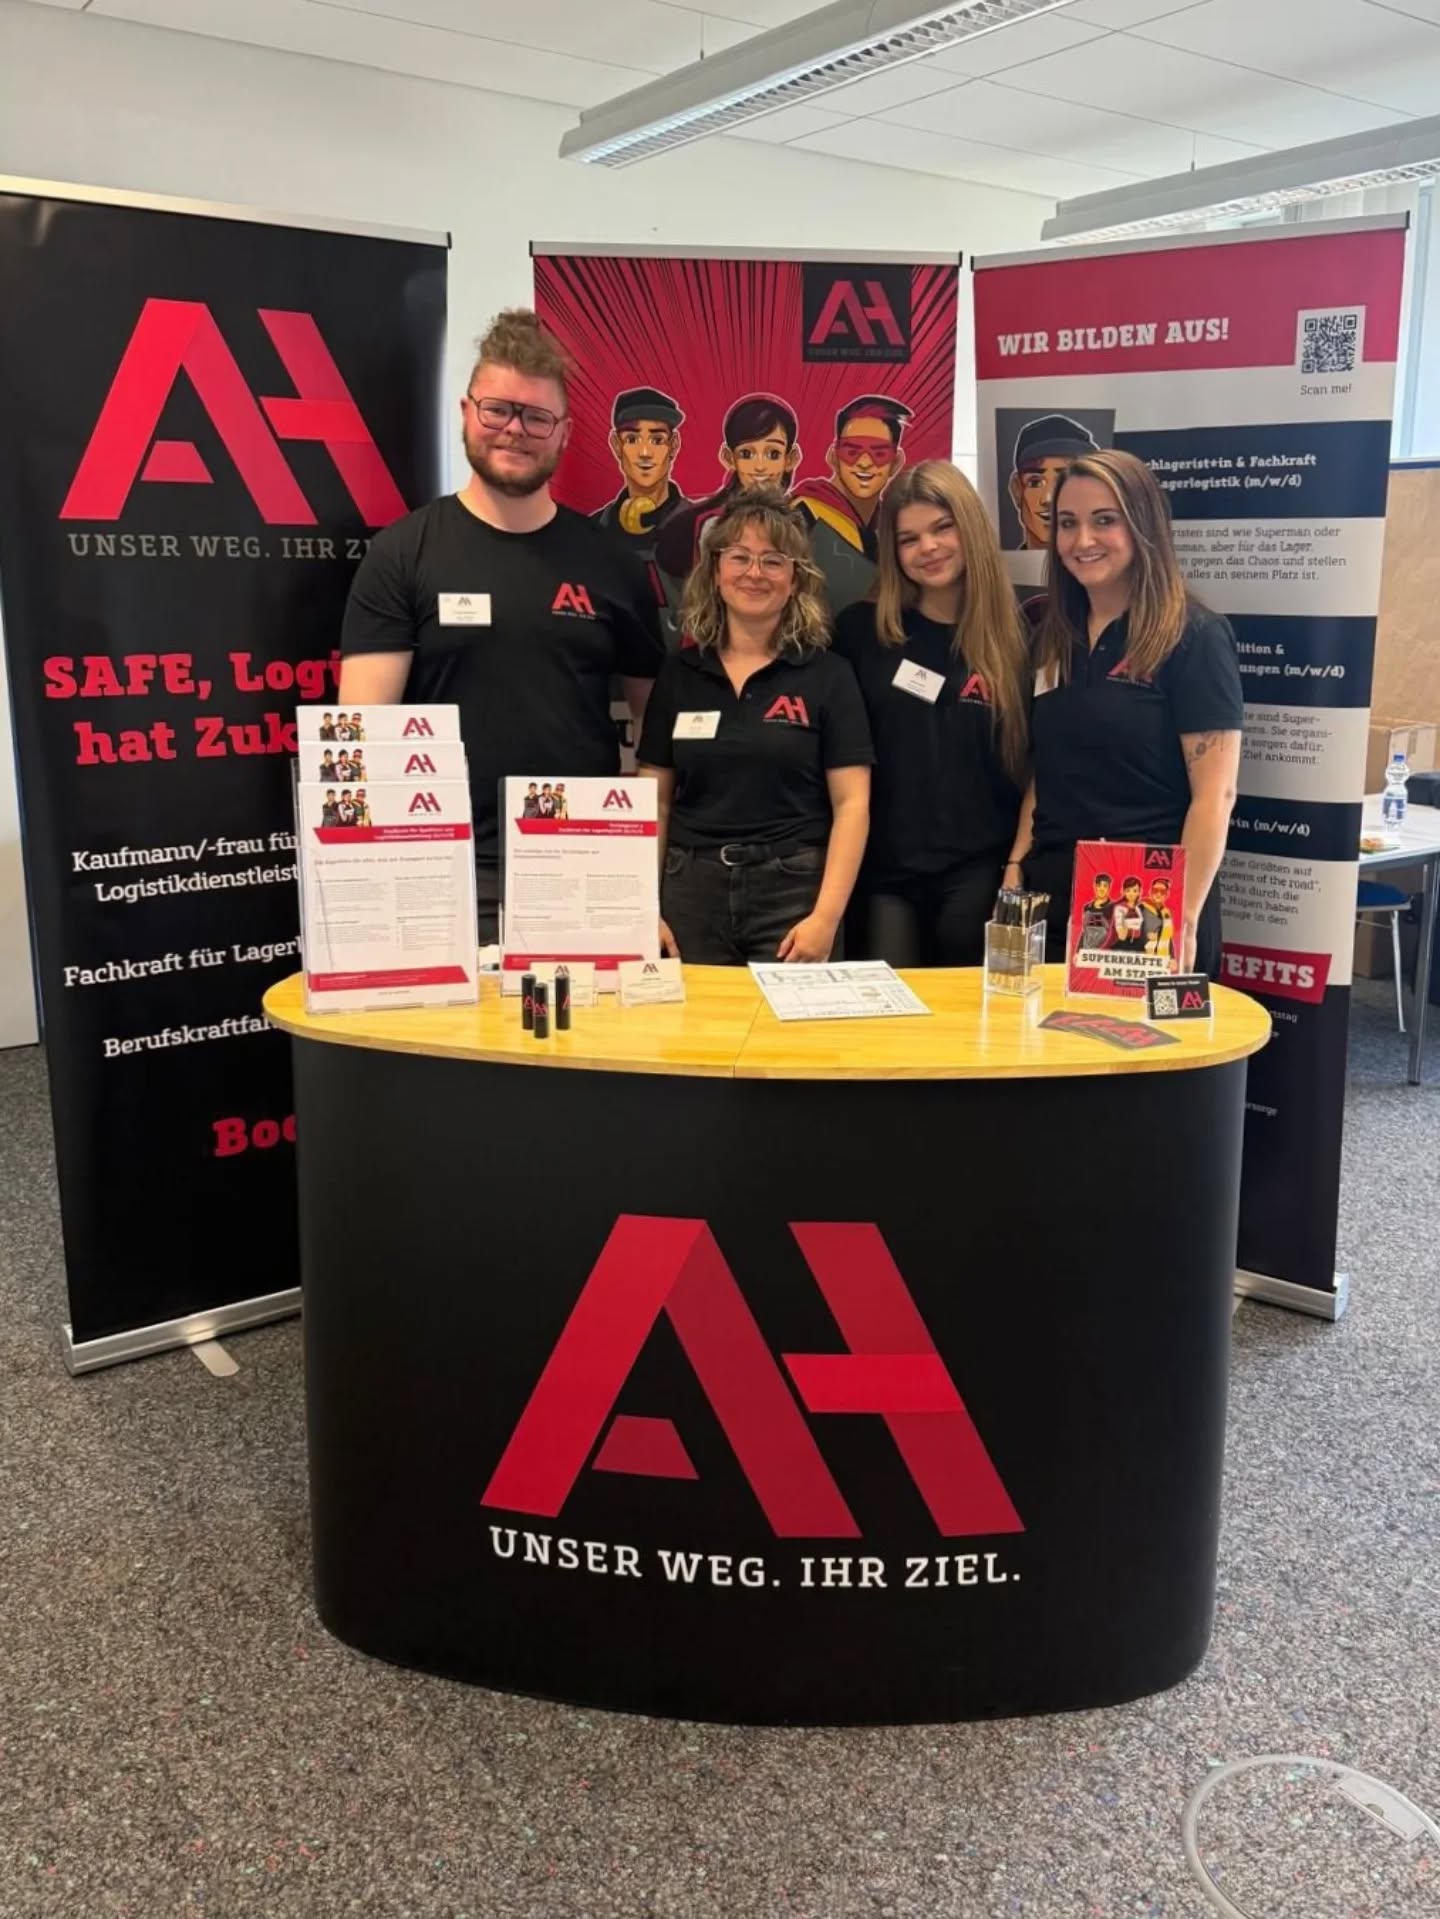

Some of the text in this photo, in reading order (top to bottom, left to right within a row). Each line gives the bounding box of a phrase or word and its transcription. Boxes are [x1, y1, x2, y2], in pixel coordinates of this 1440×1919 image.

[809, 280, 906, 345] AH
[997, 318, 1230, 356] WIR BILDEN AUS!
[1300, 382, 1352, 395] Scan me!
[59, 298, 410, 527] AH
[1236, 456, 1245, 468] &
[1250, 454, 1317, 467] Fachkraft
[1244, 474, 1302, 488] (m/w/d)
[1206, 527, 1229, 537] sind
[1232, 527, 1254, 537] wie
[1255, 526, 1311, 539] Superman
[1314, 525, 1341, 537] oder
[68, 533, 181, 557] UNSER
[190, 536, 271, 559] WEG.
[281, 538, 336, 559] IHR
[1238, 541, 1255, 552] für
[1258, 541, 1277, 551] das
[1191, 557, 1223, 568] gegen
[1226, 555, 1245, 566] das
[1248, 555, 1279, 566] Chaos
[1283, 555, 1304, 566] und
[1308, 556, 1347, 567] stellen
[1187, 569, 1210, 579] alles
[1213, 571, 1228, 579] an
[1230, 569, 1269, 580] seinem
[1272, 569, 1299, 580] Platz
[1302, 570, 1319, 580] ist.
[552, 582, 596, 616] AH
[1275, 644, 1284, 655] &
[43, 652, 212, 700] SAFE,
[1284, 663, 1345, 679] (m/w/d)
[764, 695, 809, 728] AH
[1282, 712, 1320, 726] Super-
[402, 716, 434, 737] AH
[73, 712, 298, 765] hat Zuk
[404, 753, 437, 773] AH
[408, 792, 442, 813] AH
[602, 788, 633, 809] AH
[1254, 818, 1310, 838] (m/w/d)
[72, 836, 265, 873] Kaufmann/-frau
[1146, 850, 1171, 867] AH
[1270, 875, 1287, 888] the
[64, 955, 183, 987] Fachkraft
[189, 948, 226, 969] für
[1103, 966, 1122, 978] AM
[480, 1213, 1026, 1538] AH
[489, 1526, 1022, 1588] UNSER WEG. IHR ZIEL.
